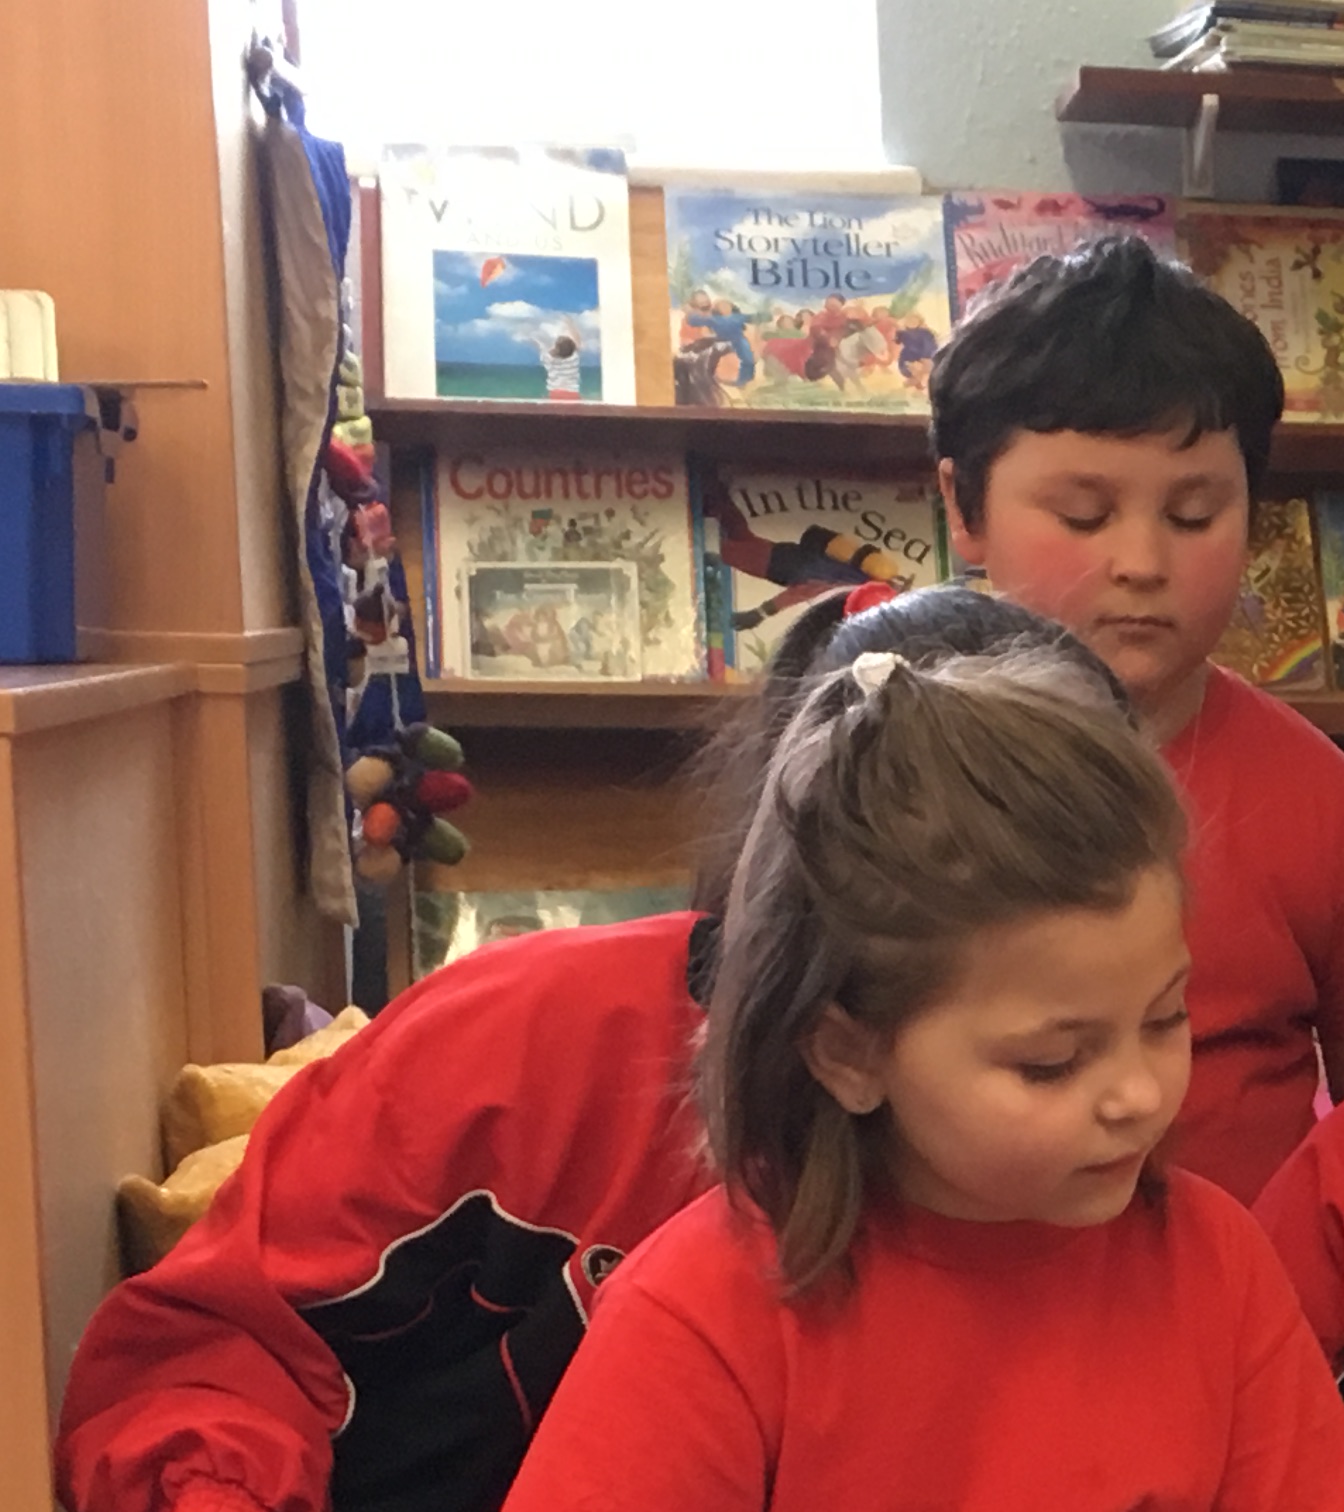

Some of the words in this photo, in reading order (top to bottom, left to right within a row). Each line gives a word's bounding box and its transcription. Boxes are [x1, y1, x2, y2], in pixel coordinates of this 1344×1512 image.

[747, 207, 799, 228] The
[808, 209, 864, 231] Lion
[714, 228, 900, 259] Storyteller
[750, 256, 872, 291] Bible
[1259, 256, 1285, 311] India
[450, 456, 675, 501] Countries
[738, 487, 789, 518] In
[794, 479, 864, 513] the
[854, 510, 932, 565] Sea
